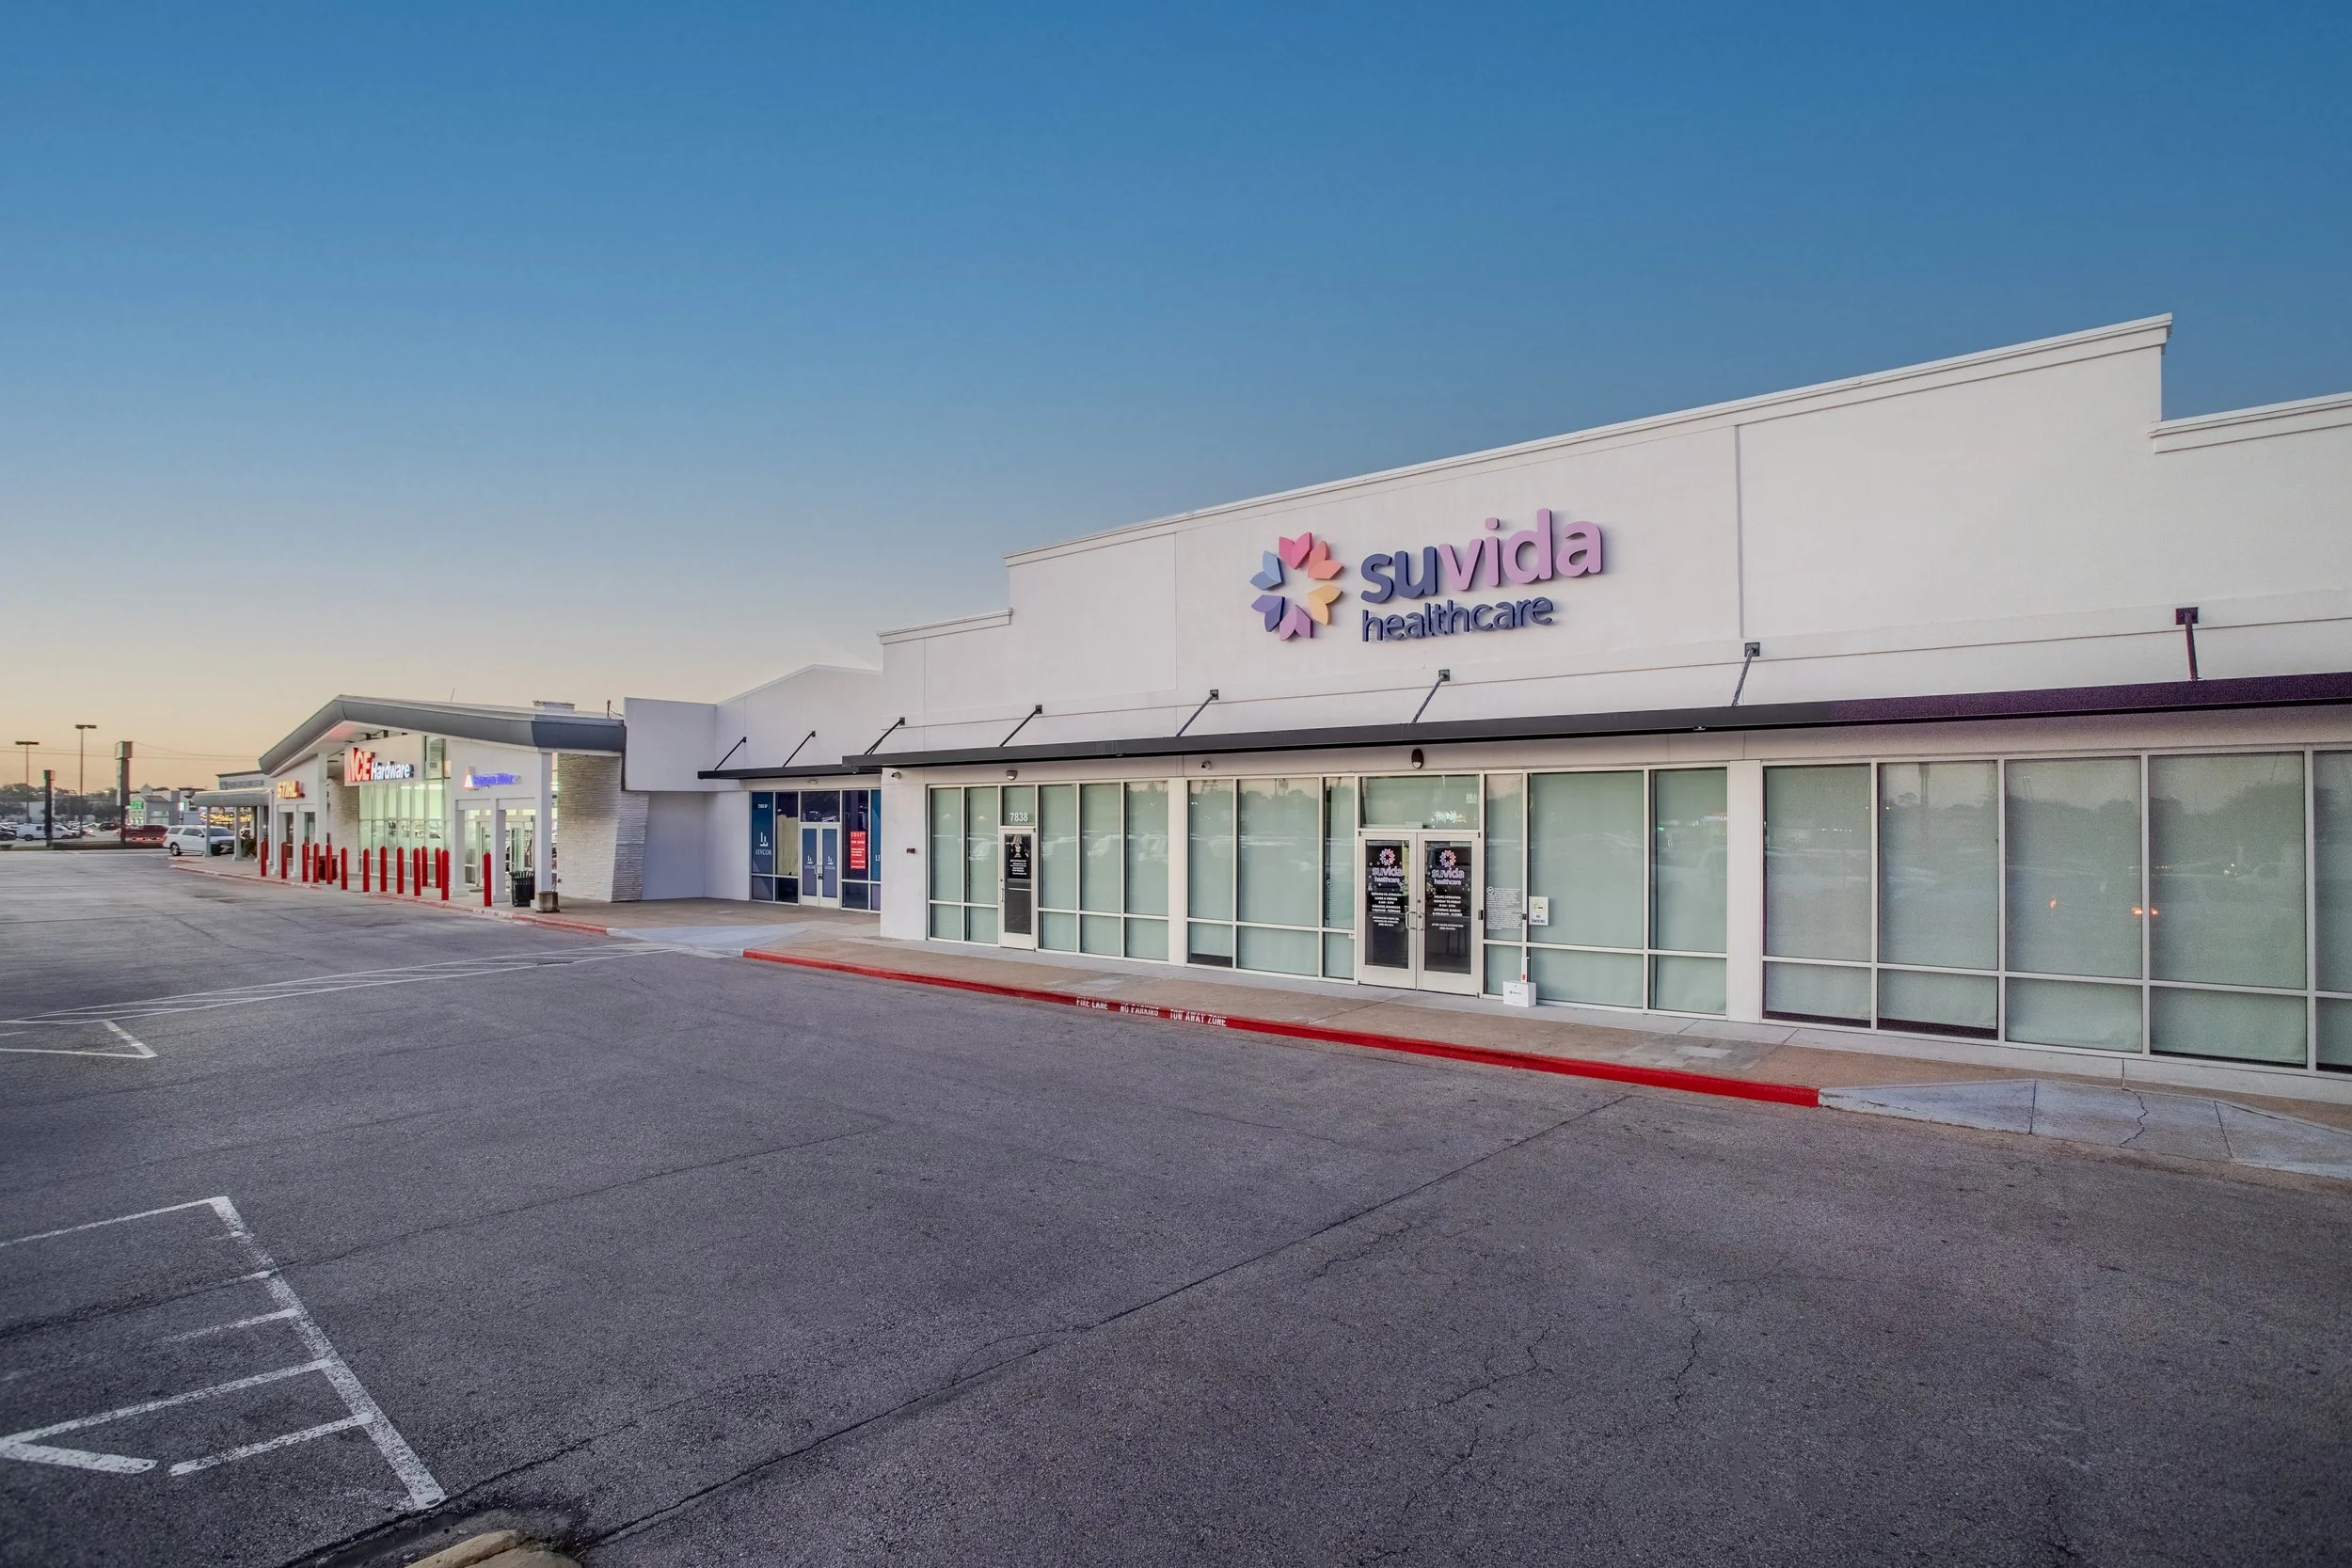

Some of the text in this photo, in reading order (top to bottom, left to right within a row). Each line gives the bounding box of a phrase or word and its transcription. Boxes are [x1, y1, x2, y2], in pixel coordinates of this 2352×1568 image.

[1360, 508, 1602, 604] suvida
[1361, 595, 1554, 642] healthcare
[346, 748, 412, 782] ACE Hardware
[278, 779, 300, 799] STIHL
[1009, 812, 1028, 822] 7838
[1372, 865, 1403, 877] suvida
[1431, 867, 1465, 879] suvida
[1076, 997, 1227, 1027] FIRE LANE NO PARKING TOW AWAY ZONE
